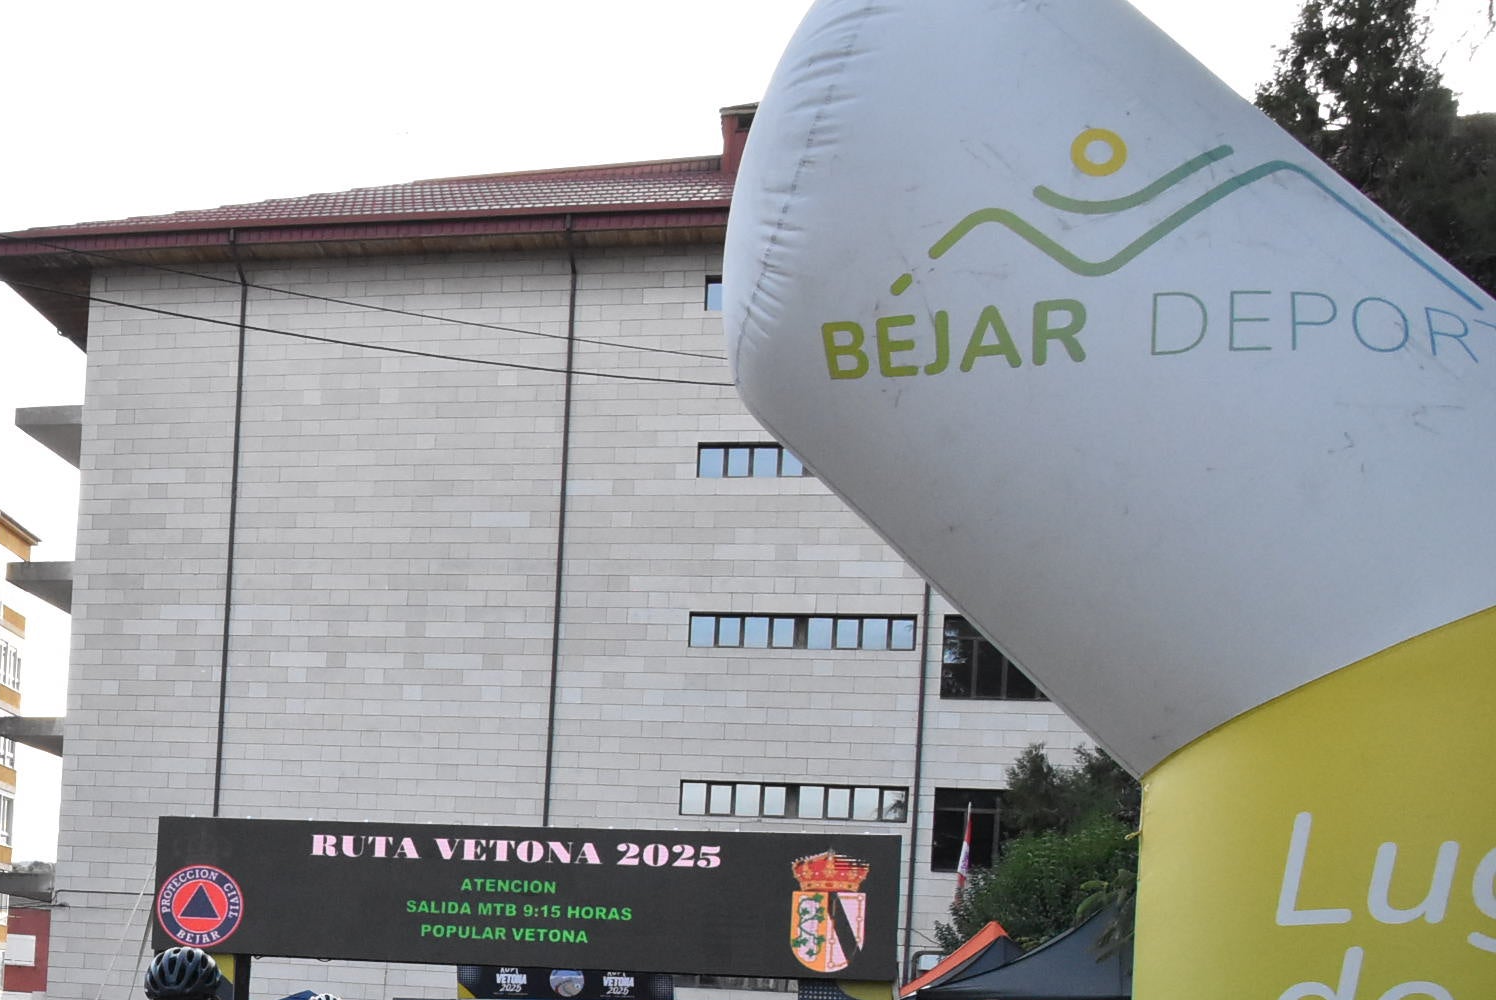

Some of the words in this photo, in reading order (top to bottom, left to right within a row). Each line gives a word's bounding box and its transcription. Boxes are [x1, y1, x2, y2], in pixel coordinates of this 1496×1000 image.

[821, 272, 1087, 380] BÉJAR
[310, 834, 422, 859] RUTA
[434, 838, 603, 866] VETONA
[616, 842, 722, 869] 2025
[161, 869, 219, 914] PROTECCION
[223, 883, 240, 919] CIVIL
[460, 878, 556, 894] ATENCION
[406, 900, 471, 915] SALIDA
[478, 903, 517, 917] MTB
[524, 904, 561, 919] 9:15
[567, 906, 633, 921] HORAS
[176, 929, 221, 944] BEJAR
[421, 924, 506, 940] POPULAR
[512, 928, 589, 944] VETONA
